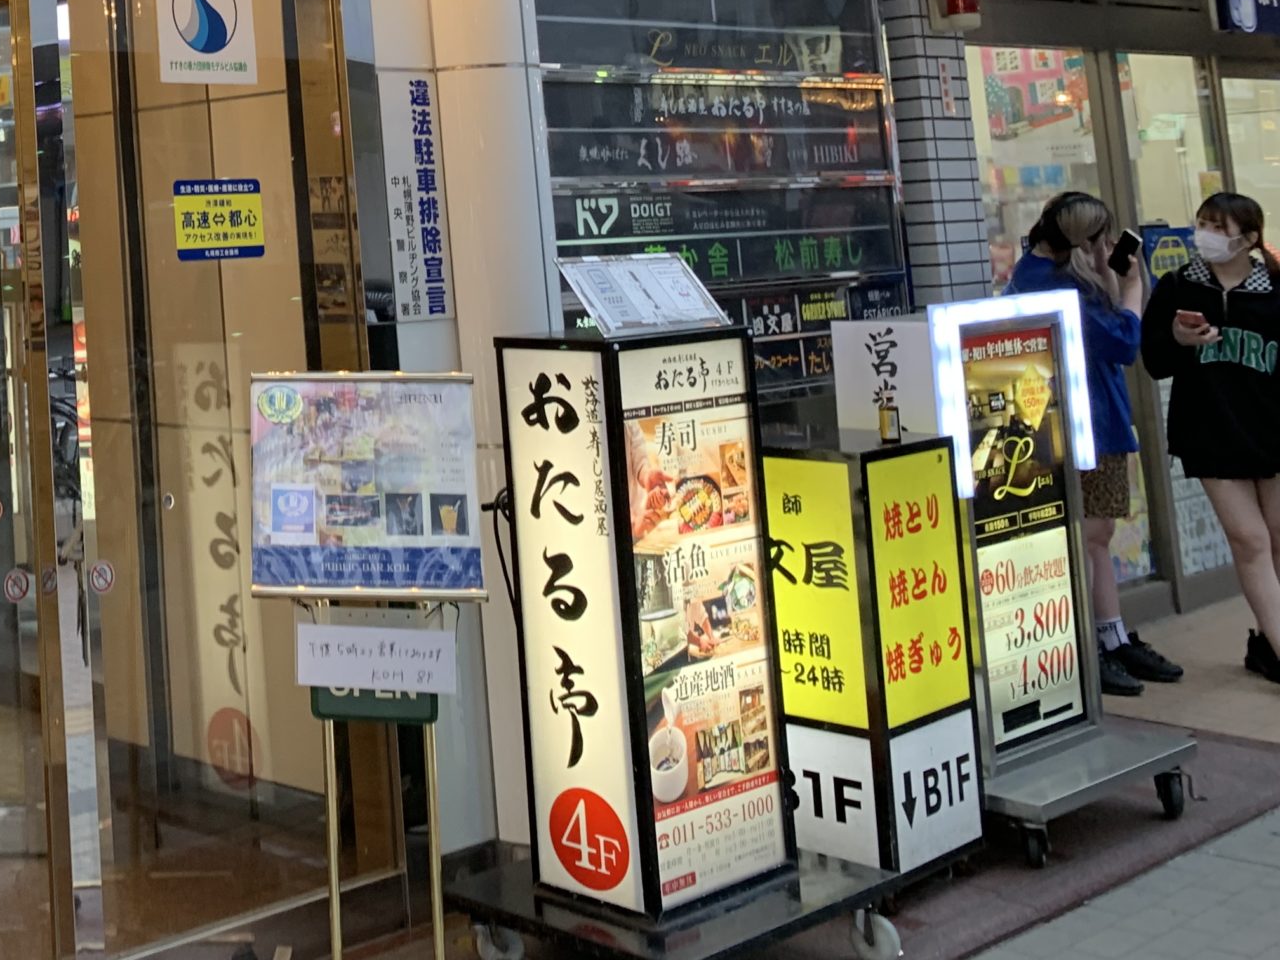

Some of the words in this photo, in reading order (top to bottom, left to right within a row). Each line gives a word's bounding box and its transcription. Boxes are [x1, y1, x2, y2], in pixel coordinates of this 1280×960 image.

[181, 211, 211, 230] 高速
[228, 209, 257, 227] 都心
[409, 79, 446, 315] 違法駐車排除宣言
[630, 202, 672, 218] DOIGT
[391, 177, 410, 316] 中央警察署
[774, 235, 863, 273] 松前寿し
[654, 356, 710, 393] おたる亭
[655, 418, 698, 457] 寿司
[883, 492, 941, 542] 焼とり
[520, 371, 599, 769] おたる亭
[663, 543, 709, 585] 活魚
[888, 559, 948, 611] 焼とん
[1005, 594, 1070, 652] ¥3,800
[673, 661, 736, 703] 道産地酒
[885, 626, 963, 686] 焼ぎゅう
[1010, 641, 1075, 700] ¥4,800
[922, 752, 971, 819] B1F
[561, 798, 622, 876] 4F
[672, 794, 774, 847] 011-533-1000
